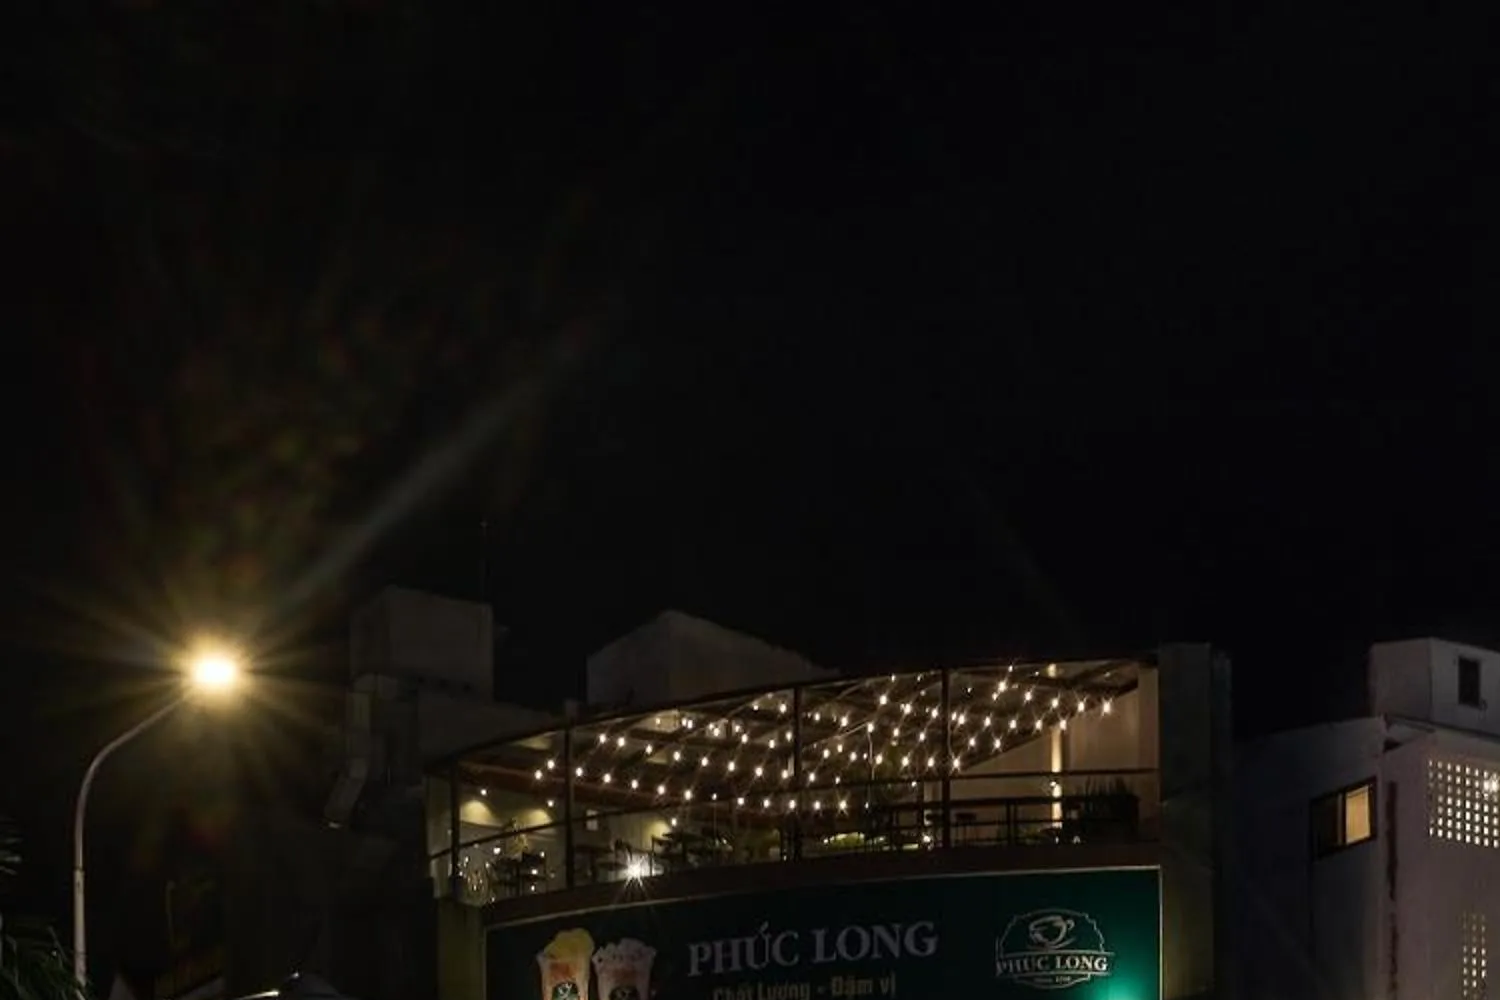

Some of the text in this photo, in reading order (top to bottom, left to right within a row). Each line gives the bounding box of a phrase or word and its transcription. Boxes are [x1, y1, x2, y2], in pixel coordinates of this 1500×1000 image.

[687, 919, 939, 977] PHÚC LONG
[1055, 955, 1109, 972] LONG
